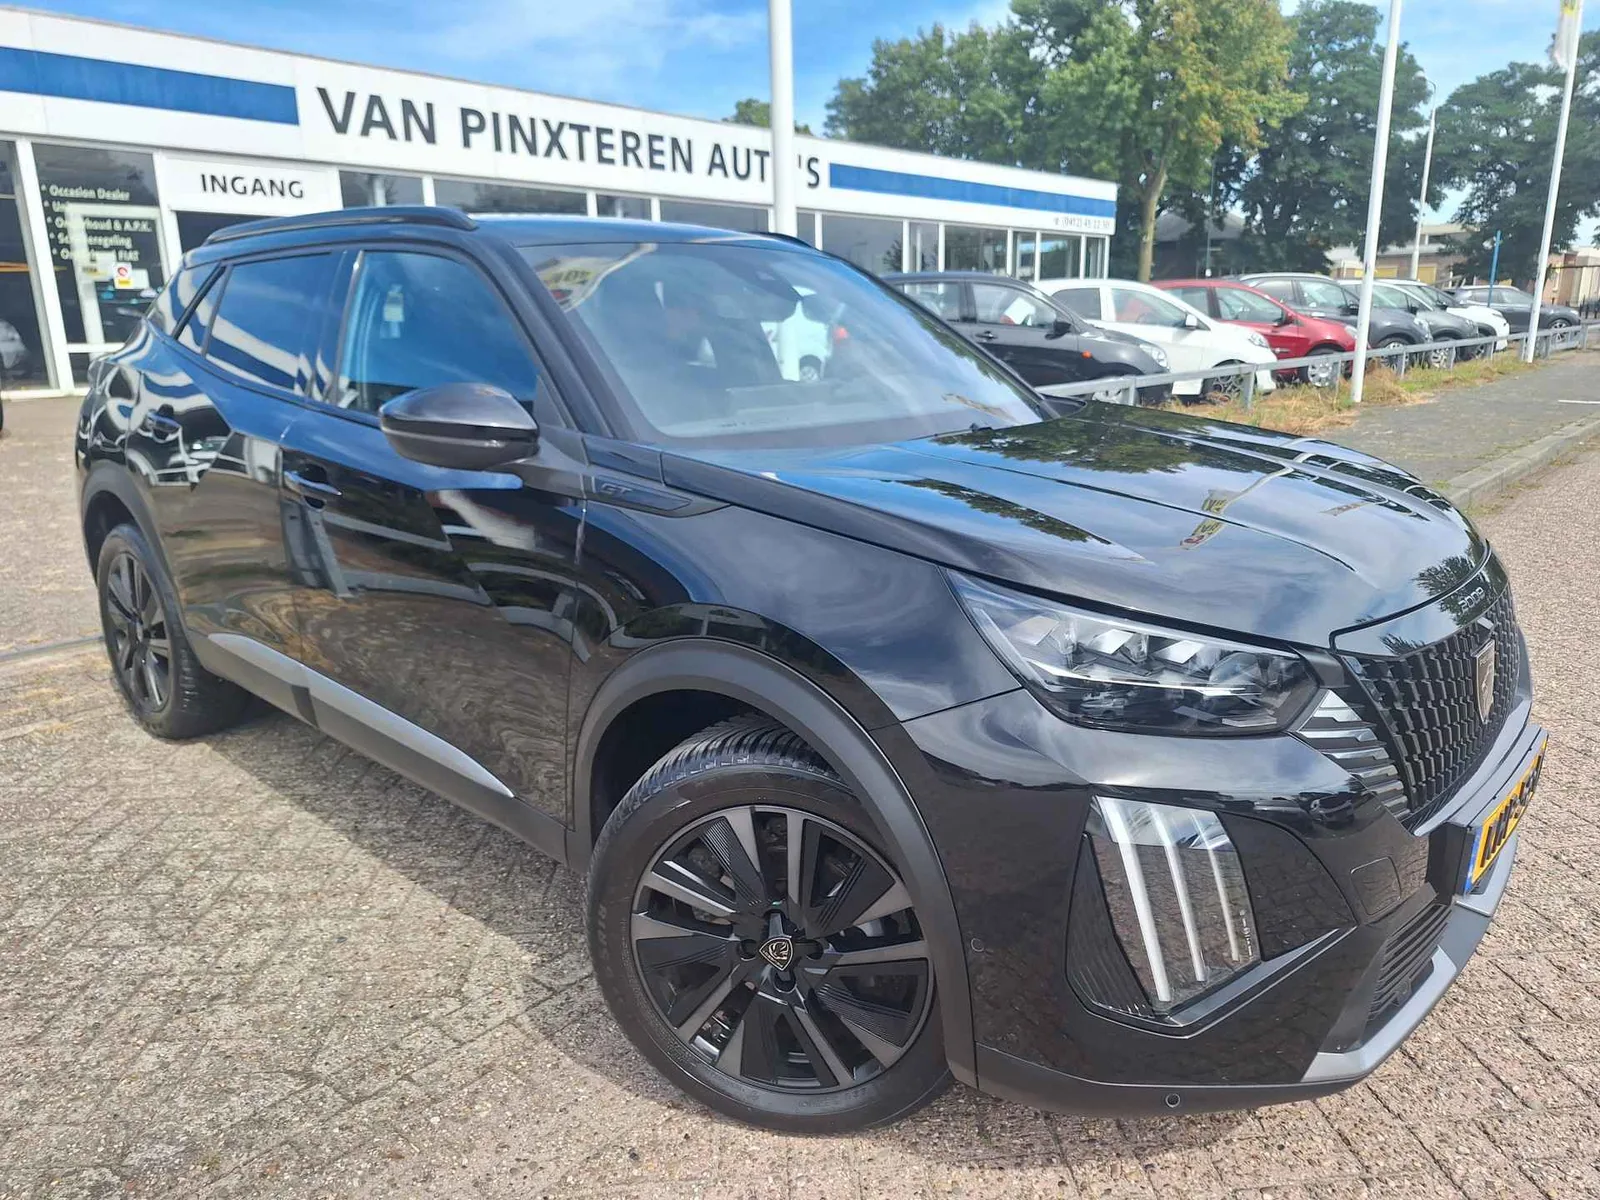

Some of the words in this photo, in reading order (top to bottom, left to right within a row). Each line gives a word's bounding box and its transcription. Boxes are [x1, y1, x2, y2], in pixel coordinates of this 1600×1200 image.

[316, 86, 437, 145] VAN
[460, 107, 694, 175] PINXTEREN
[707, 143, 820, 189] AUT'S
[49, 184, 97, 199] Occasion
[97, 187, 130, 201] Dealer
[201, 174, 303, 199] INGANG
[113, 219, 122, 231] &
[602, 482, 633, 499] GT
